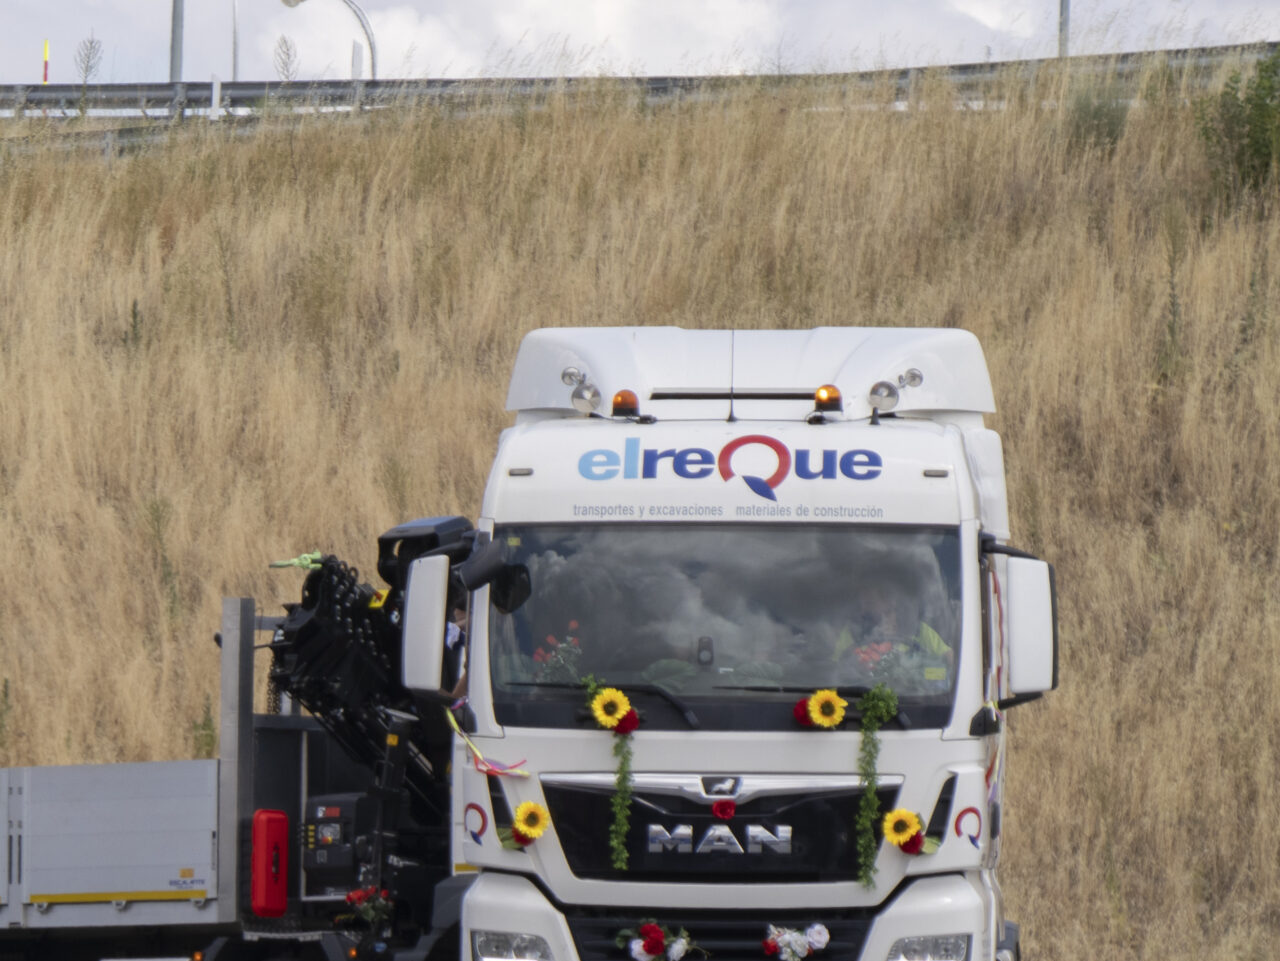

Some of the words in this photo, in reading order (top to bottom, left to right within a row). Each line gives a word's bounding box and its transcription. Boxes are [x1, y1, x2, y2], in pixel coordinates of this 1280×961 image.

[577, 434, 883, 502] elreQue
[572, 503, 634, 518] transportes
[638, 505, 645, 518] y
[648, 503, 723, 517] excavaciones
[735, 503, 792, 517] materiales
[796, 504, 810, 517] de
[813, 504, 884, 519] construcción
[647, 824, 793, 853] MAN
